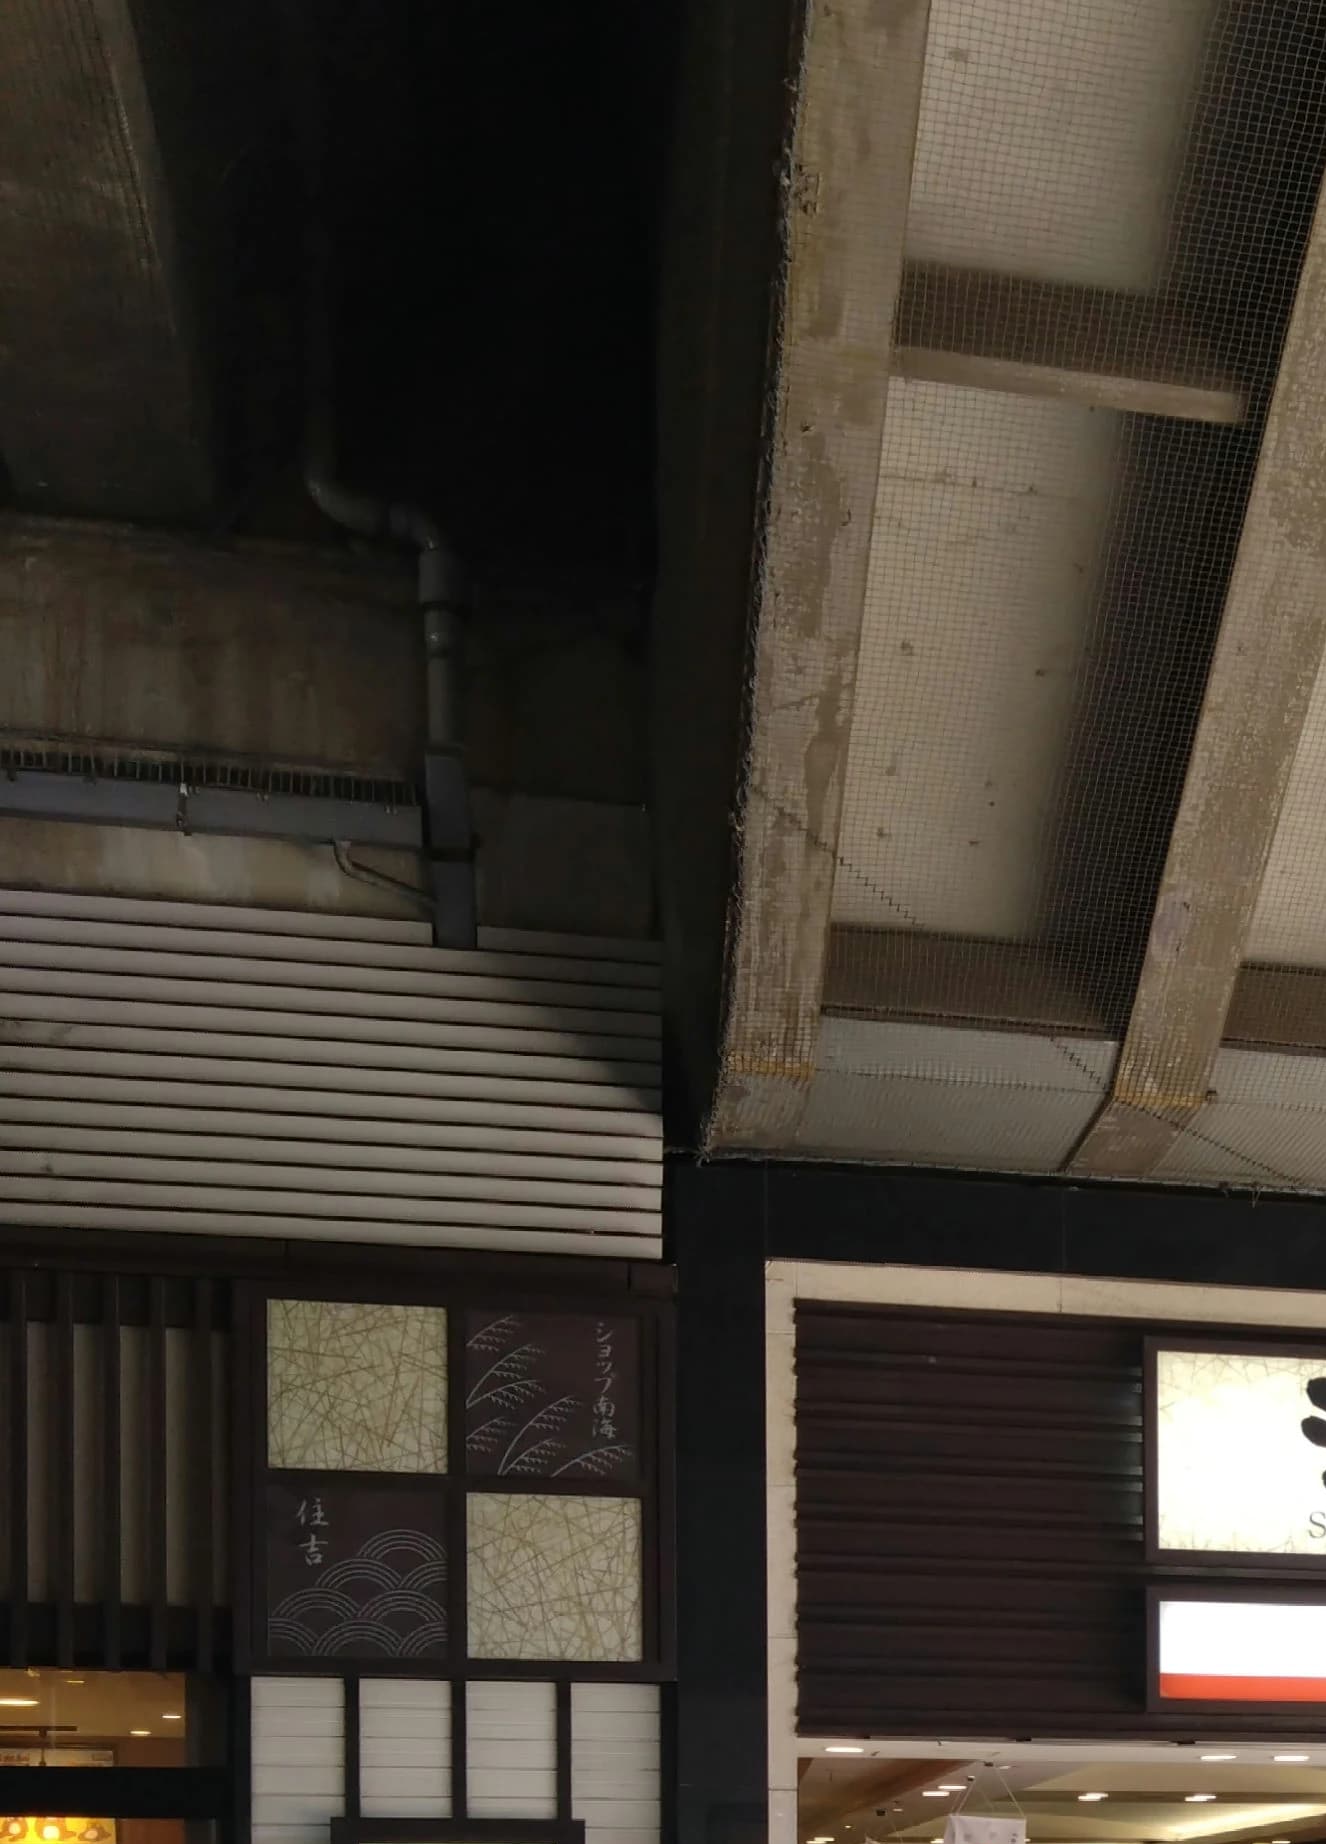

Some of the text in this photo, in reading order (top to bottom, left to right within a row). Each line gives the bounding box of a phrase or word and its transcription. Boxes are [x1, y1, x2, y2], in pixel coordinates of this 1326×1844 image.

[593, 1322, 617, 1439] ショップ南海
[296, 1497, 329, 1566] 住吉
